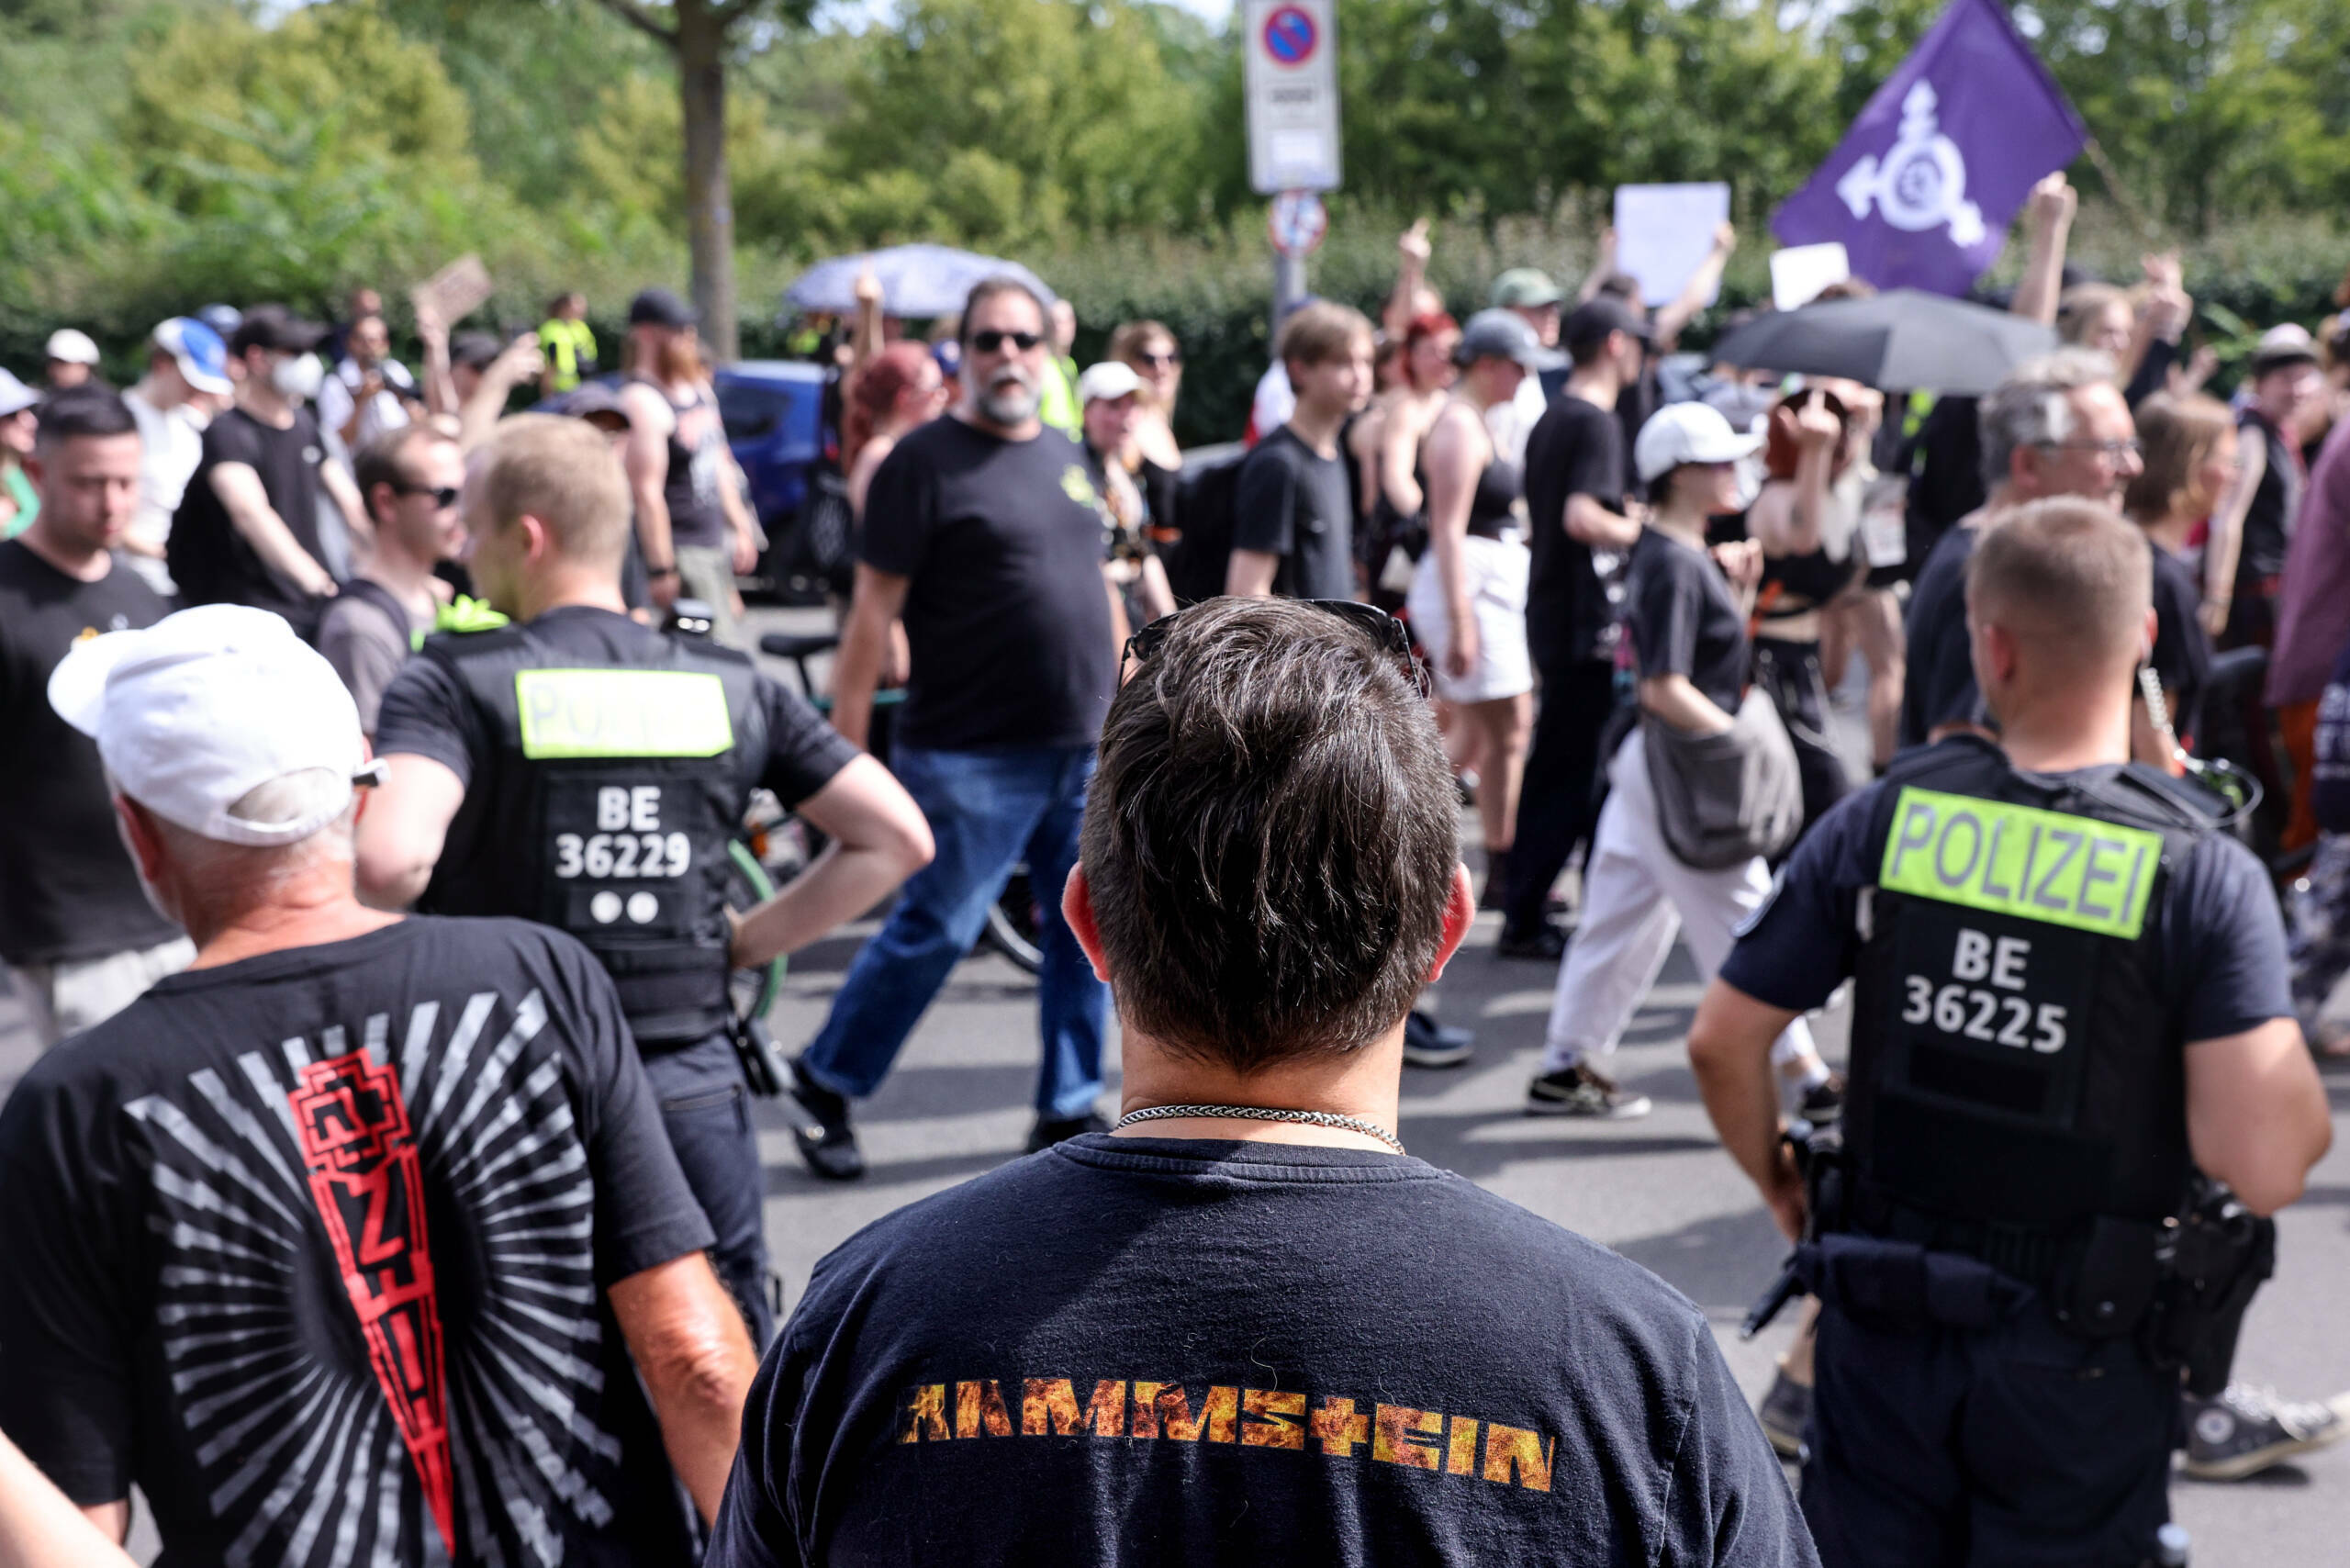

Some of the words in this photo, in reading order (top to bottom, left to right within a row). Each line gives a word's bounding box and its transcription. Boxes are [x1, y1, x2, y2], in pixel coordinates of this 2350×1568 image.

[598, 786, 662, 832] BE
[554, 832, 691, 879] 36229
[1891, 802, 2146, 927] POLIZEI
[1952, 927, 2031, 991] BE
[1901, 974, 2067, 1054] 36225
[896, 1378, 1555, 1493] RAMMSTEIN
